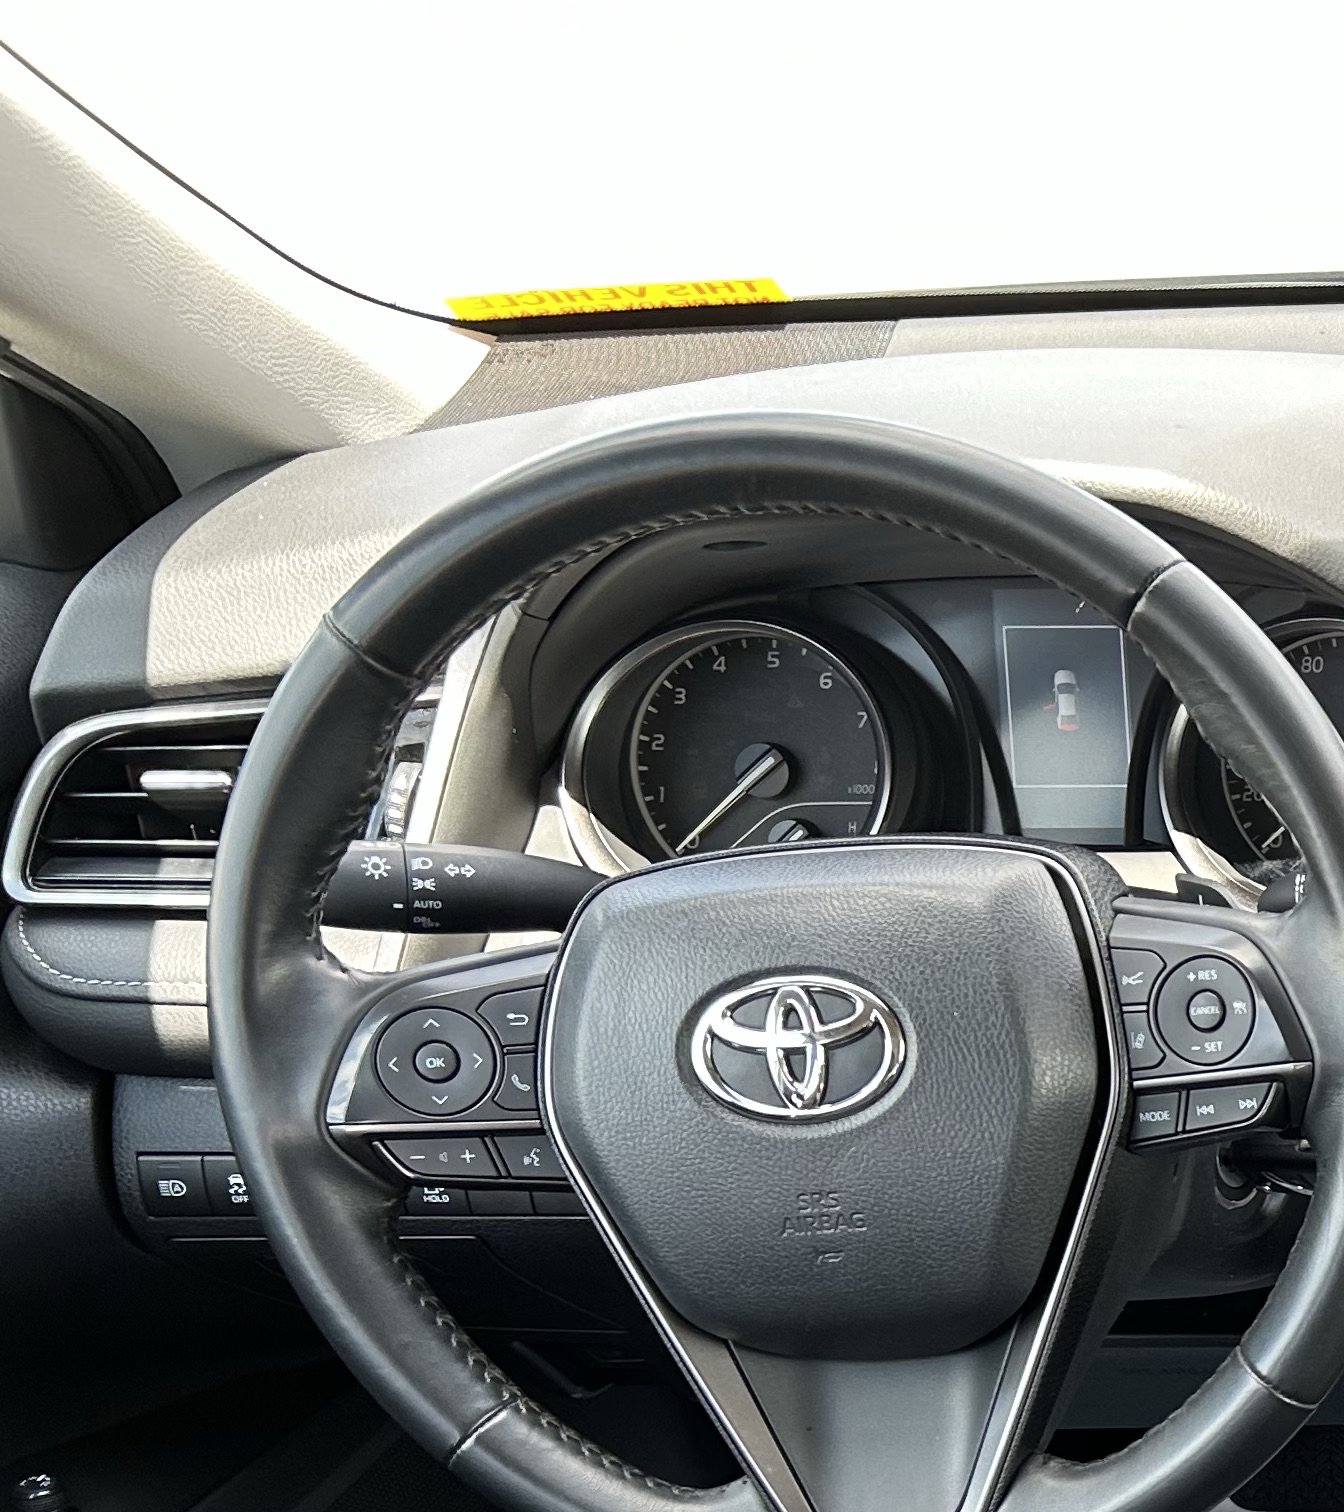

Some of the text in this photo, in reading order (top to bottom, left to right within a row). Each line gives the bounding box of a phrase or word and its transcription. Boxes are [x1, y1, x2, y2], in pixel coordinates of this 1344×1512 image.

[712, 657, 727, 674] 4
[767, 652, 780, 669] 5
[1301, 656, 1324, 674] 80
[819, 672, 833, 689] 6
[674, 688, 687, 705] 3
[857, 712, 869, 730] 7
[651, 734, 665, 751] 2
[657, 787, 665, 803] 1
[848, 822, 857, 835] H
[413, 900, 442, 909] AUTO
[1191, 1005, 1220, 1016] CANCEL
[426, 1057, 445, 1069] OK
[1139, 1110, 1171, 1122] MODE
[423, 1191, 450, 1203] HOLD
[796, 1191, 842, 1213] SRS
[780, 1211, 868, 1238] AIRBAG
